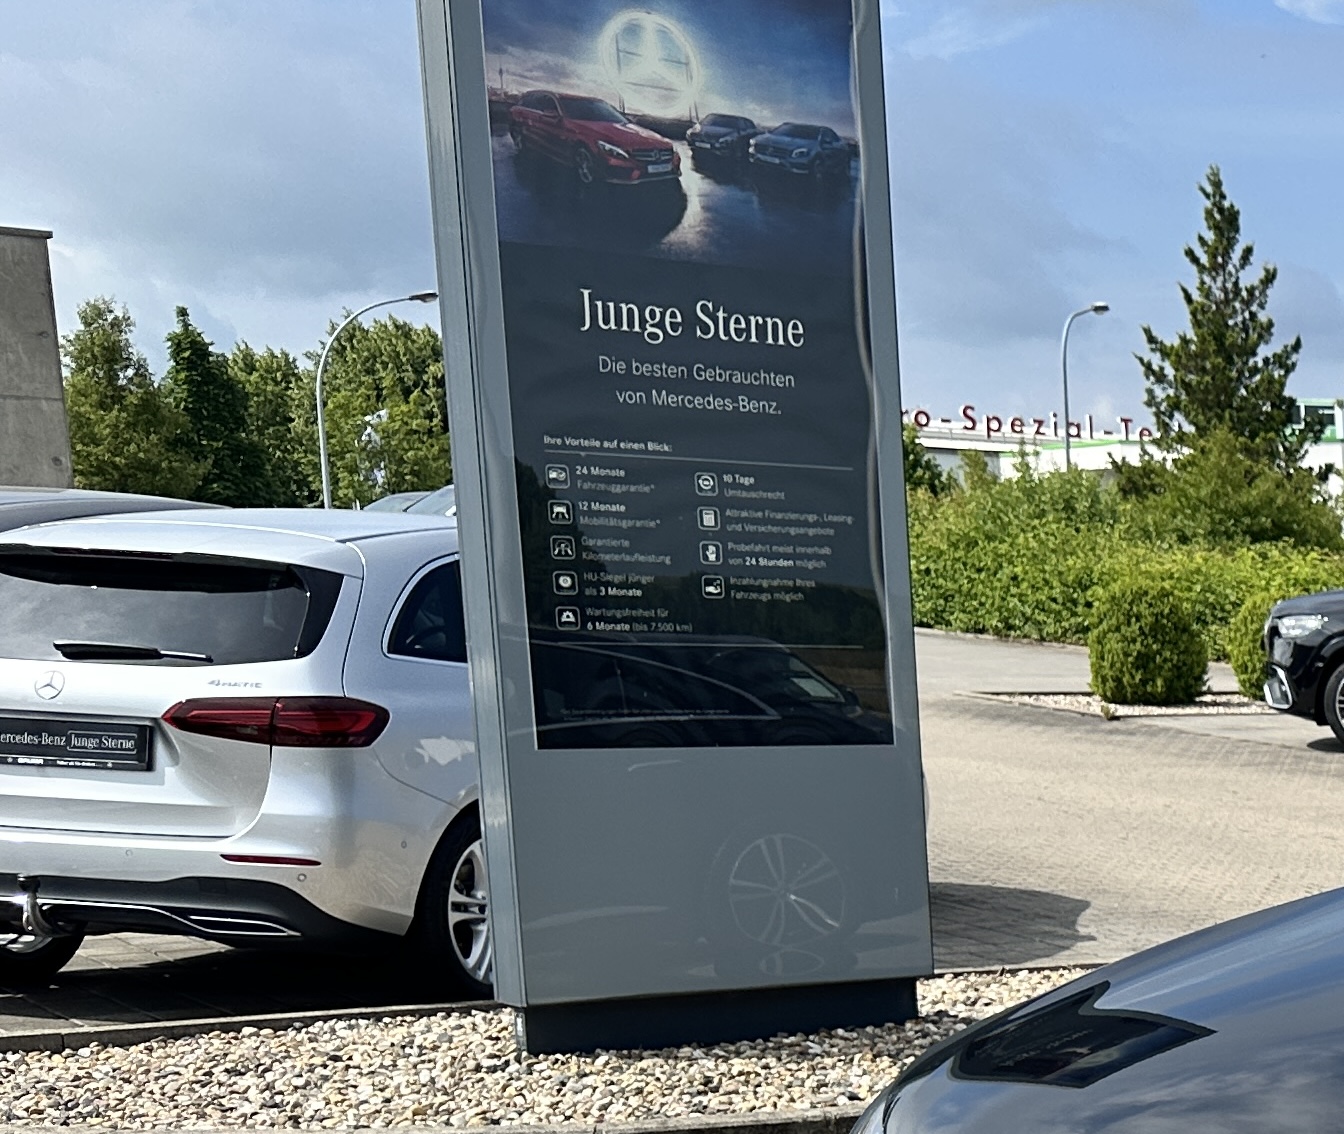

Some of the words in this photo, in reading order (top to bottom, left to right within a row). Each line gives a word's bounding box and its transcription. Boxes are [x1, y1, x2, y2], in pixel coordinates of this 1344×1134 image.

[580, 288, 683, 344] Junge
[696, 300, 805, 348] Sterne
[598, 355, 627, 374] Die
[632, 358, 688, 379] besten
[693, 364, 795, 388] Gebrauchten
[616, 390, 646, 404] von
[652, 389, 782, 415] Mercedes-Benz.
[543, 435, 562, 446] Ihre
[564, 436, 601, 448] Vorteile
[603, 439, 618, 449] auf
[620, 440, 645, 450] einen
[575, 466, 588, 475] 24
[590, 466, 626, 477] Monate
[723, 474, 733, 483] 10
[735, 474, 755, 486] Tage
[578, 501, 588, 510] 12
[591, 502, 626, 513] Monate
[745, 557, 756, 566] 24
[758, 557, 794, 567] Stunden
[608, 587, 642, 597] Monate
[587, 622, 593, 631] 6
[596, 621, 630, 632] Monate
[0, 731, 66, 747] ercedes-Benz
[70, 734, 99, 749] Junge
[101, 736, 135, 749] Sterne
